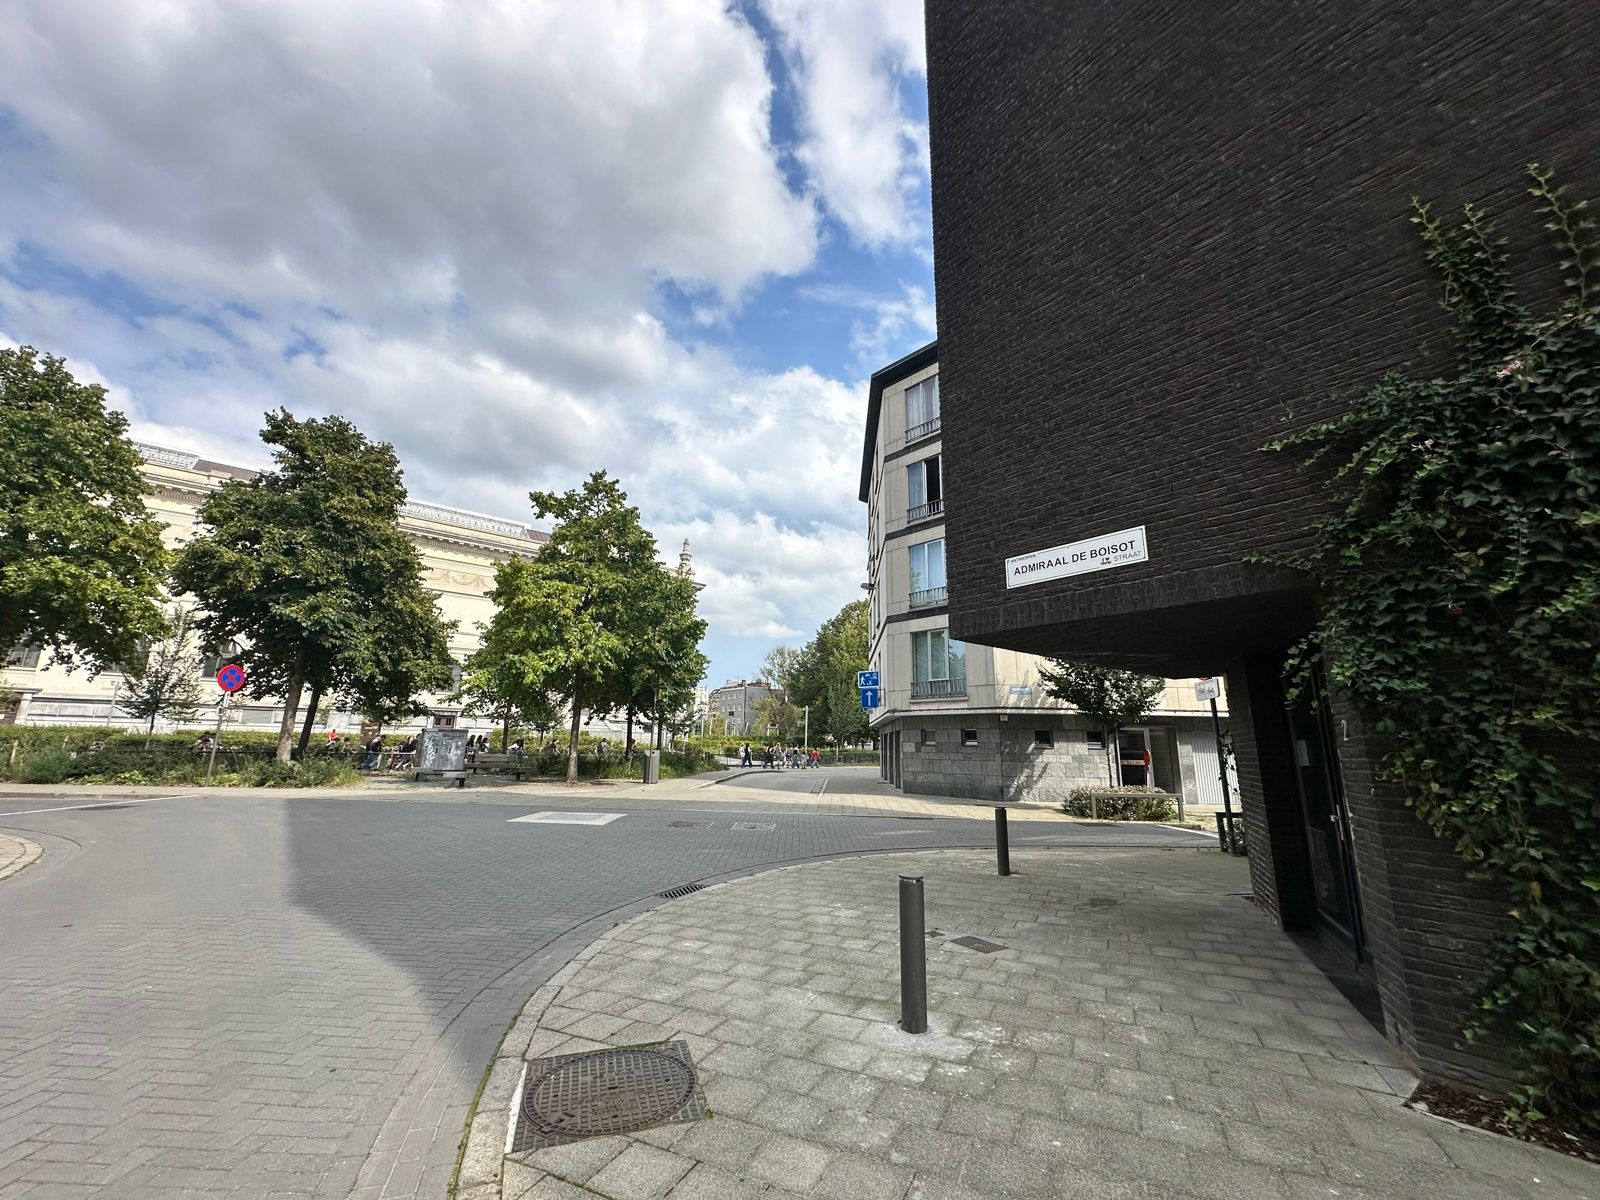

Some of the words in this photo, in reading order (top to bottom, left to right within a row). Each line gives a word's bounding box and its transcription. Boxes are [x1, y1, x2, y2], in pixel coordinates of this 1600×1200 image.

[1011, 554, 1036, 562] ANTWERPEN
[1014, 557, 1069, 575] ADMIRAAL
[1072, 551, 1087, 562] DE
[1090, 540, 1136, 558] BOISOT
[1114, 551, 1141, 561] STRAAT
